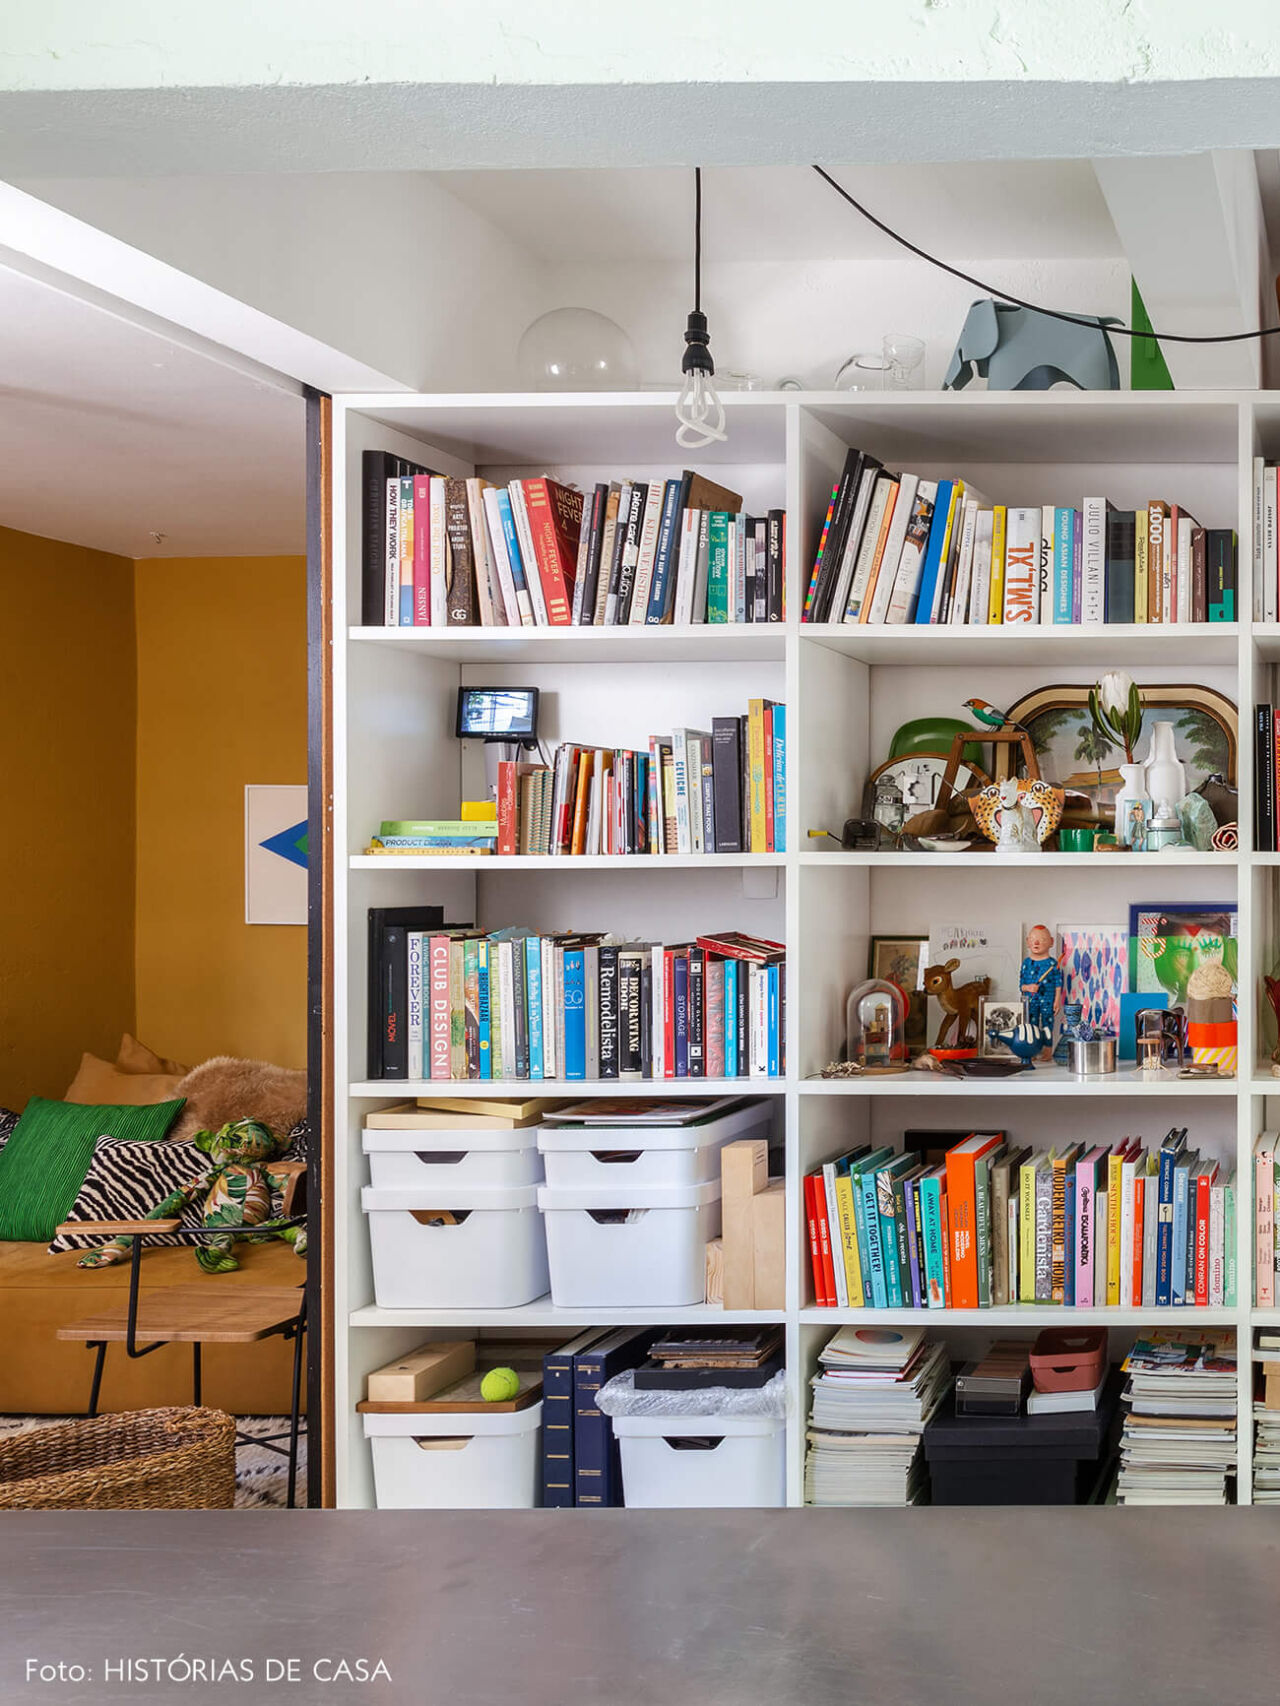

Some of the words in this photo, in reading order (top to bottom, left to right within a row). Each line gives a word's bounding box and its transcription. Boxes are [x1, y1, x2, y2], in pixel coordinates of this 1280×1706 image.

[389, 485, 397, 507] HOW
[631, 491, 643, 522] pierre
[389, 509, 397, 531] THEY
[542, 522, 555, 549] NIGHT
[642, 517, 656, 546] KELLY
[699, 513, 708, 549] nendo
[1060, 510, 1069, 541] YOUNG
[1087, 503, 1100, 536] JULIO
[1149, 505, 1163, 545] 1000
[389, 533, 397, 560] WORK
[547, 549, 559, 575] FEVER
[1060, 542, 1069, 569] ASIAN
[1087, 541, 1099, 585] VILLANI
[634, 551, 653, 609] WEARSTLER
[1059, 569, 1069, 613] DESIGNERS
[417, 586, 427, 621] JANSEN
[675, 760, 686, 797] CEVICHE
[433, 946, 448, 991] CLUB
[512, 942, 522, 982] JONATHAN
[479, 996, 489, 1023] BAZAAR
[513, 982, 522, 1006] ADLER
[620, 977, 629, 1011] BOOK
[599, 966, 616, 1062] Remodelista
[628, 977, 640, 1053] DECORATING
[676, 994, 686, 1038] STORAGE
[433, 999, 448, 1067] DESIGN
[865, 1191, 876, 1209] GET
[927, 1191, 936, 1216] AWAY
[1052, 1166, 1065, 1210] MODERN
[1162, 1180, 1171, 1202] CONRAN
[866, 1212, 878, 1221] IT
[929, 1217, 937, 1227] AT
[977, 1191, 986, 1234] BEAUTIFUL
[929, 1228, 938, 1254] HOME
[978, 1235, 987, 1257] MESS
[1035, 1196, 1052, 1280] Gardenista
[1052, 1214, 1065, 1246] RETRO
[1110, 1218, 1119, 1248] HOUSE
[1198, 1219, 1207, 1247] COLOR
[867, 1223, 882, 1274] TOGETHER!
[1197, 1246, 1207, 1260] ON
[1051, 1261, 1065, 1291] HOME
[1197, 1260, 1207, 1295] CONRAN
[1212, 1257, 1221, 1294] domino
[1228, 1258, 1236, 1295] domino
